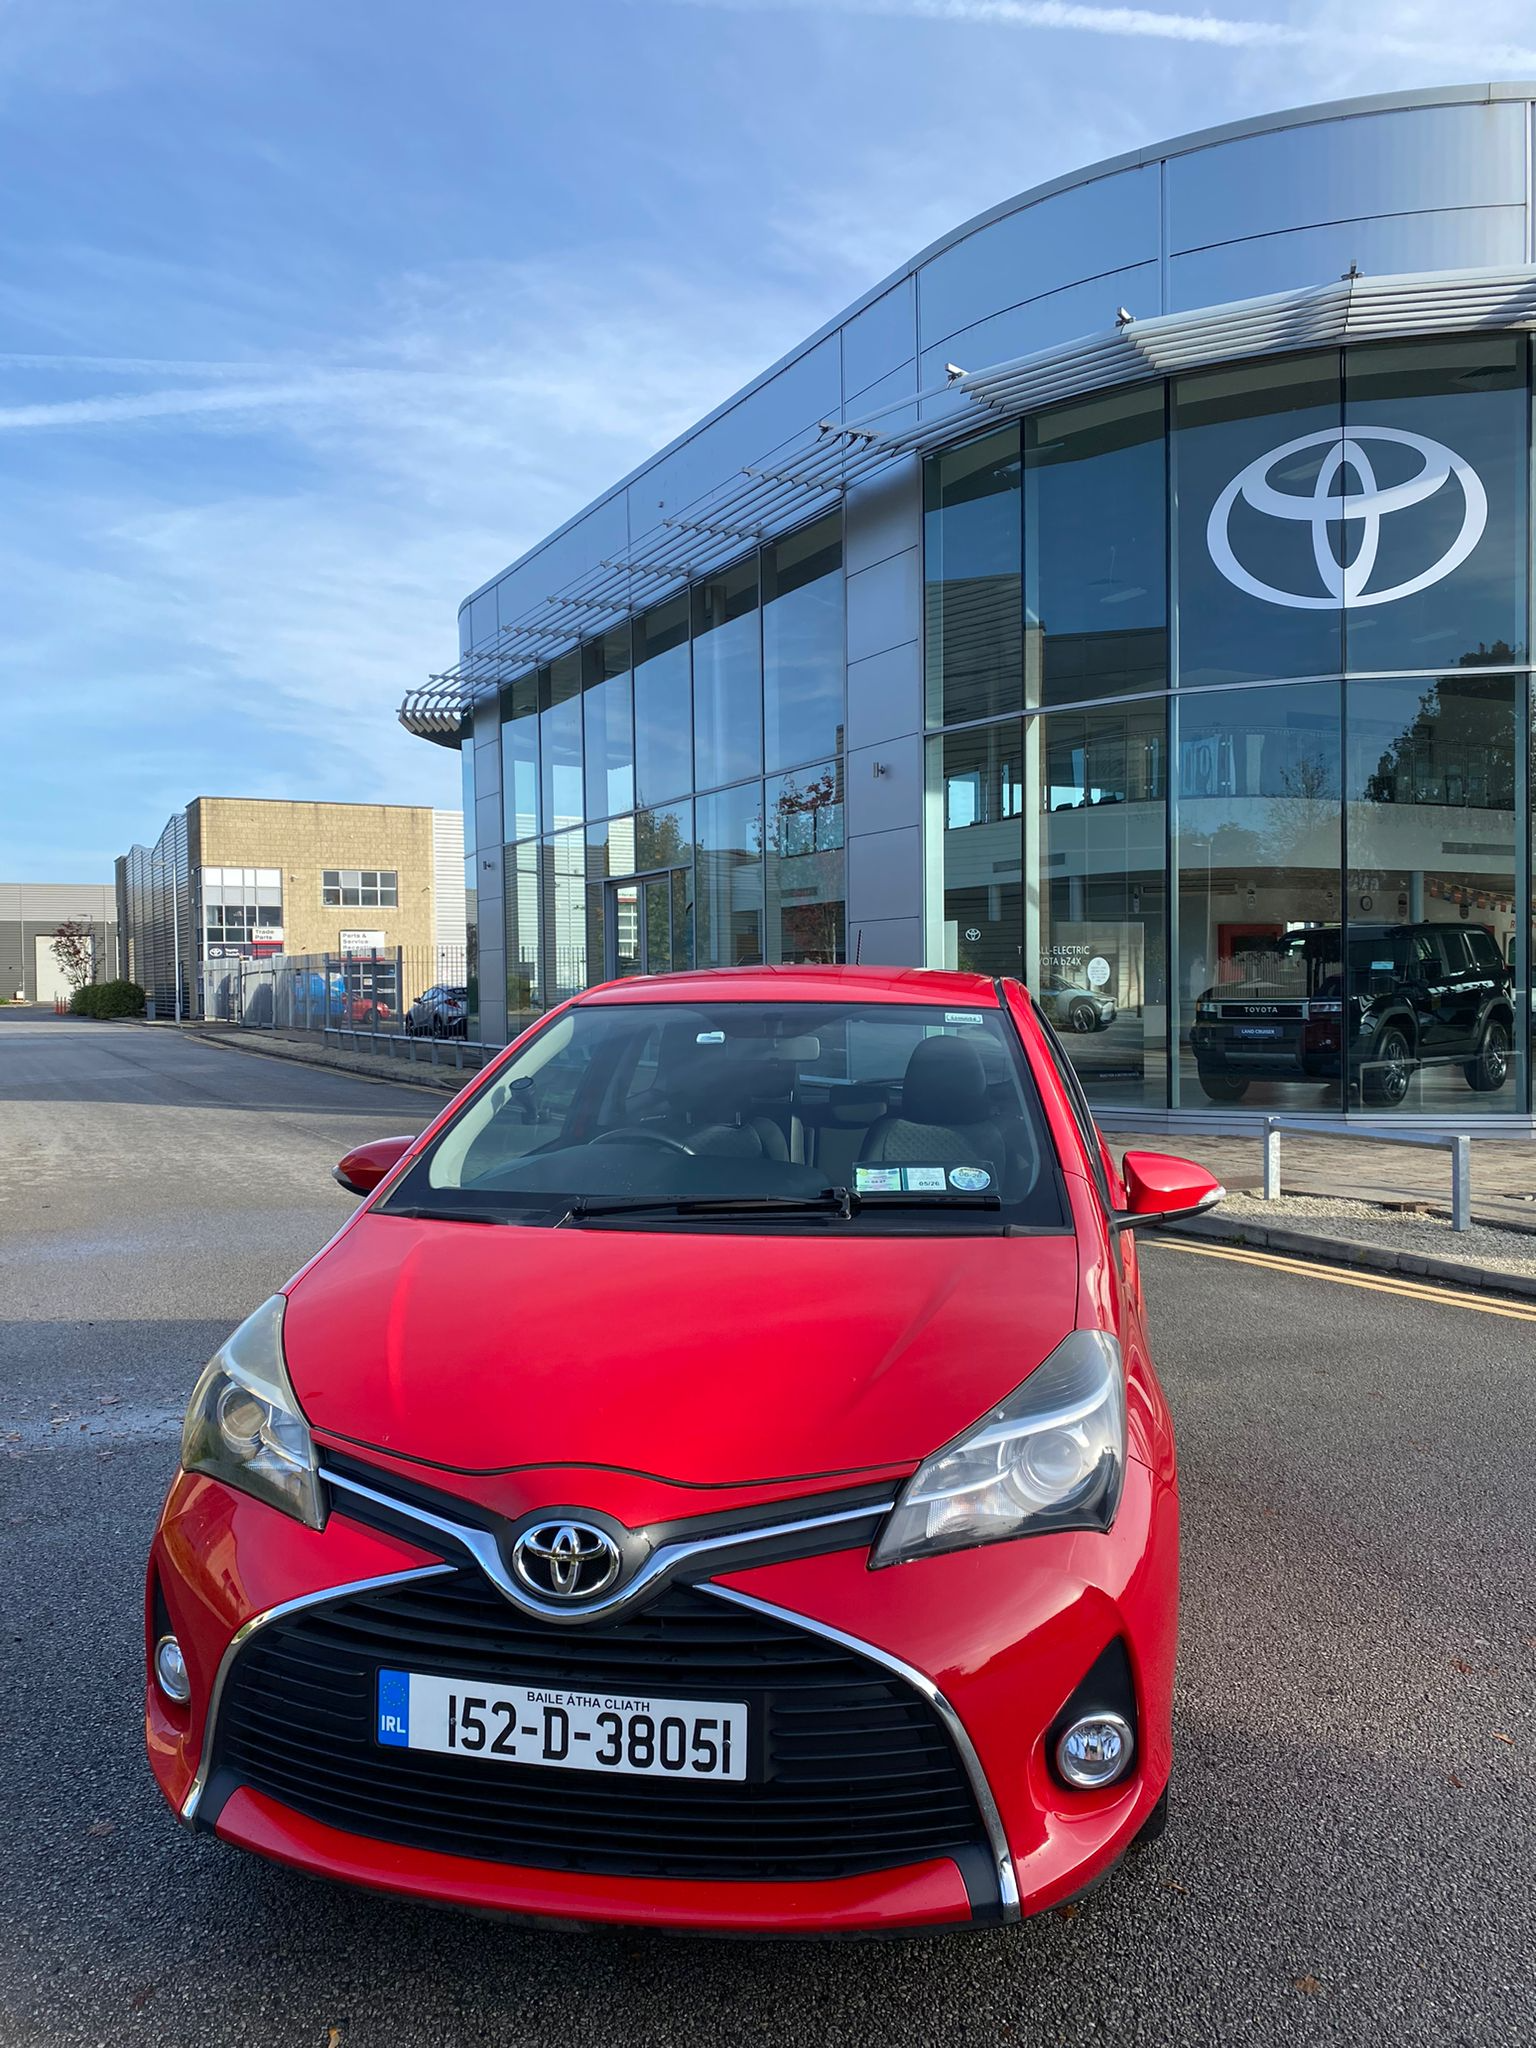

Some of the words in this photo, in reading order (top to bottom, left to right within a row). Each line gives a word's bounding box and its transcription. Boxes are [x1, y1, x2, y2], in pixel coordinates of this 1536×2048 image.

[1039, 945, 1090, 955] LL-ELECTRIC
[1060, 957, 1082, 966] bZ4X
[527, 1691, 564, 1705] BAILE
[566, 1693, 601, 1708] ÁTHA
[604, 1698, 651, 1712] CLIATH
[381, 1715, 406, 1734] IRL
[447, 1694, 731, 1774] 152-D-38051
